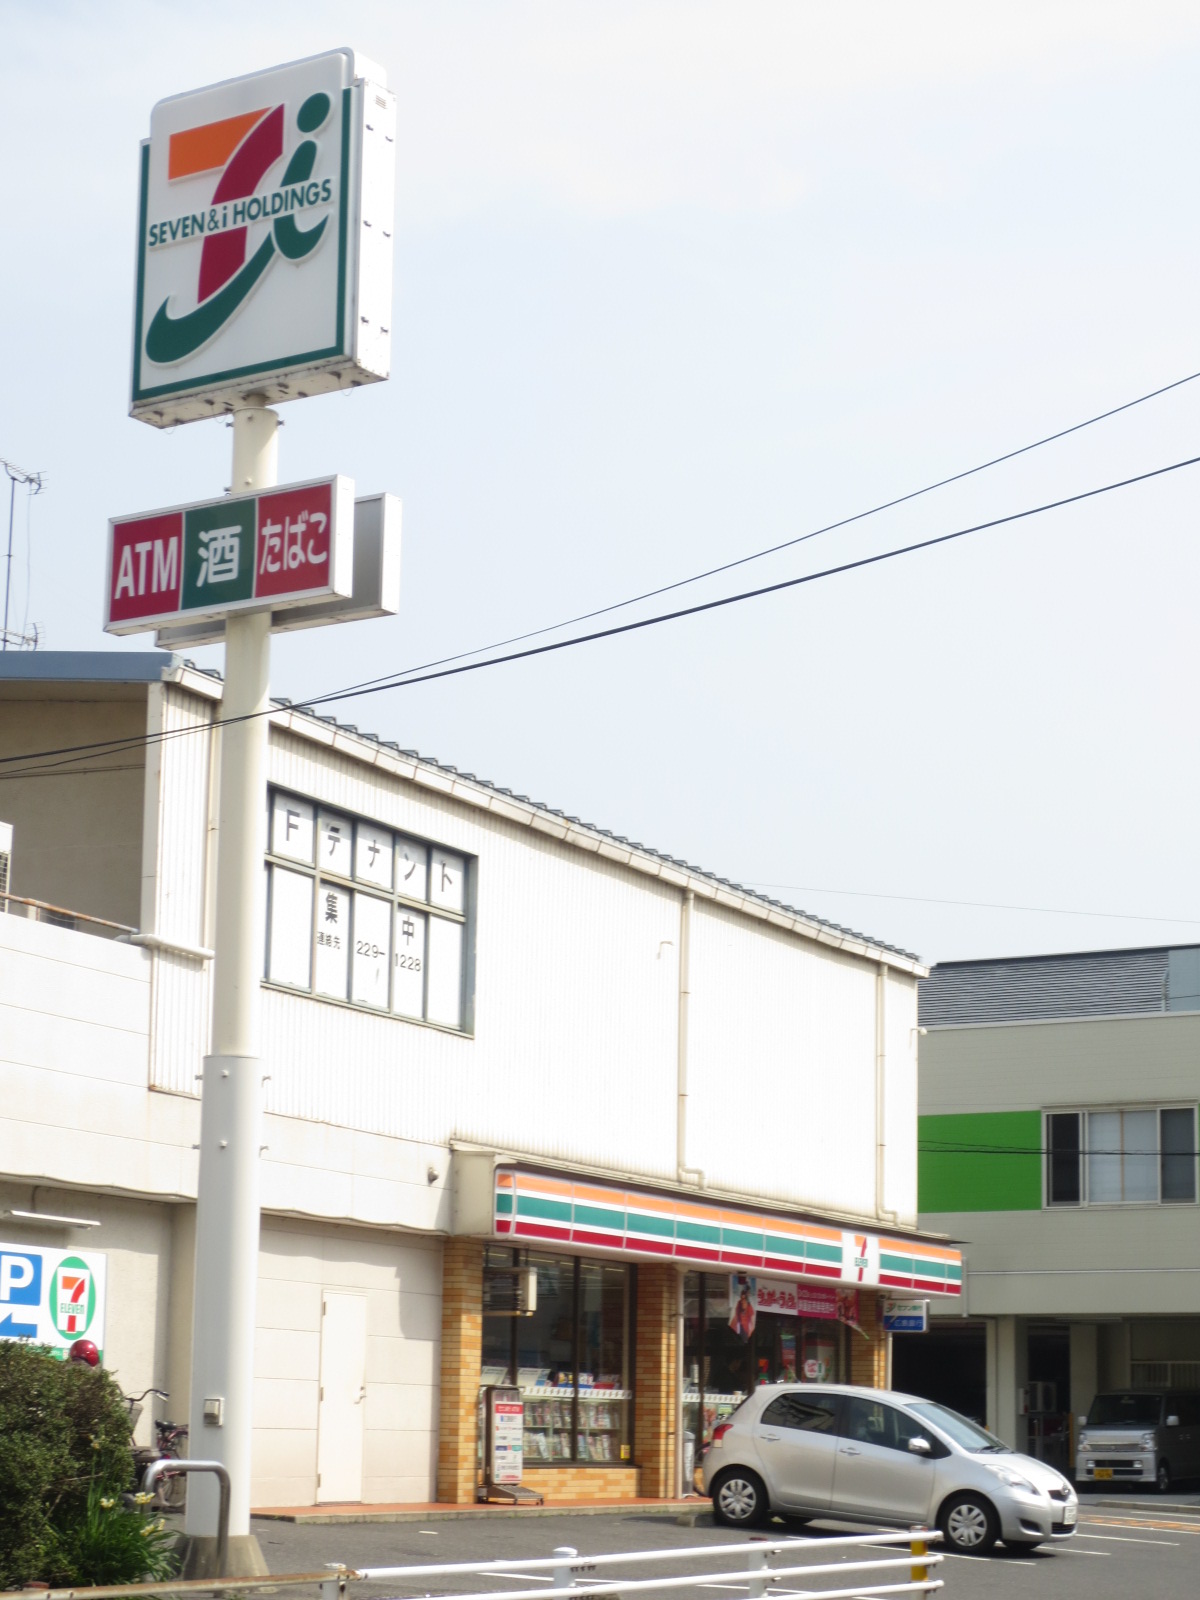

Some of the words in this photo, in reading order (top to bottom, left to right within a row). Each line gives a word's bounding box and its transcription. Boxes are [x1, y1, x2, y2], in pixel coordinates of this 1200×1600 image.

[233, 178, 332, 224] HOLDINGS
[115, 536, 178, 599] ATM
[196, 525, 242, 587] 酒
[260, 510, 328, 575] たばこ
[1, 1254, 35, 1301] P
